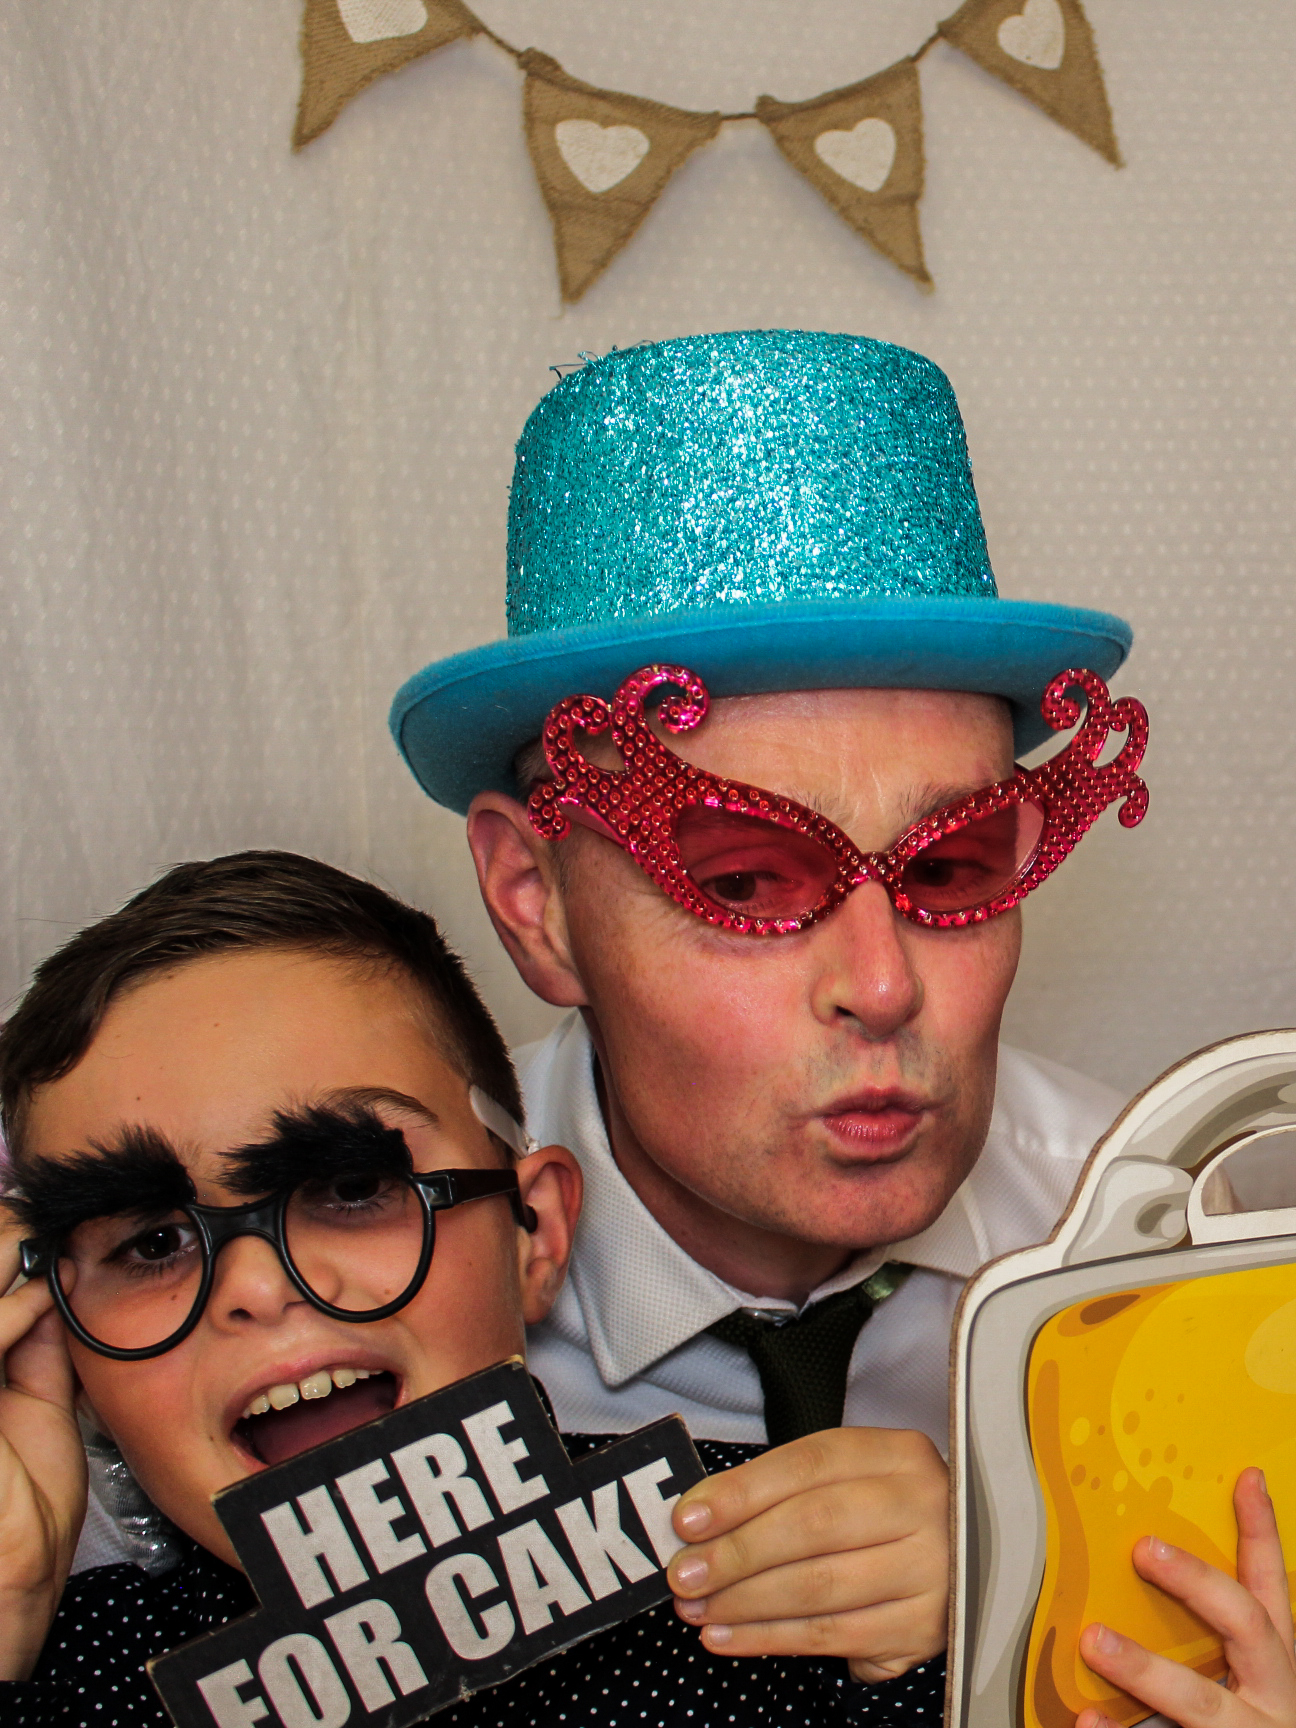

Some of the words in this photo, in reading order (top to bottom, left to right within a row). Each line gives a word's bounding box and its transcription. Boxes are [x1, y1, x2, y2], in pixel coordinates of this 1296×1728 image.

[196, 1598, 430, 1728] FOR
[424, 1456, 689, 1662] CAKE
[260, 1400, 551, 1610] HERE
